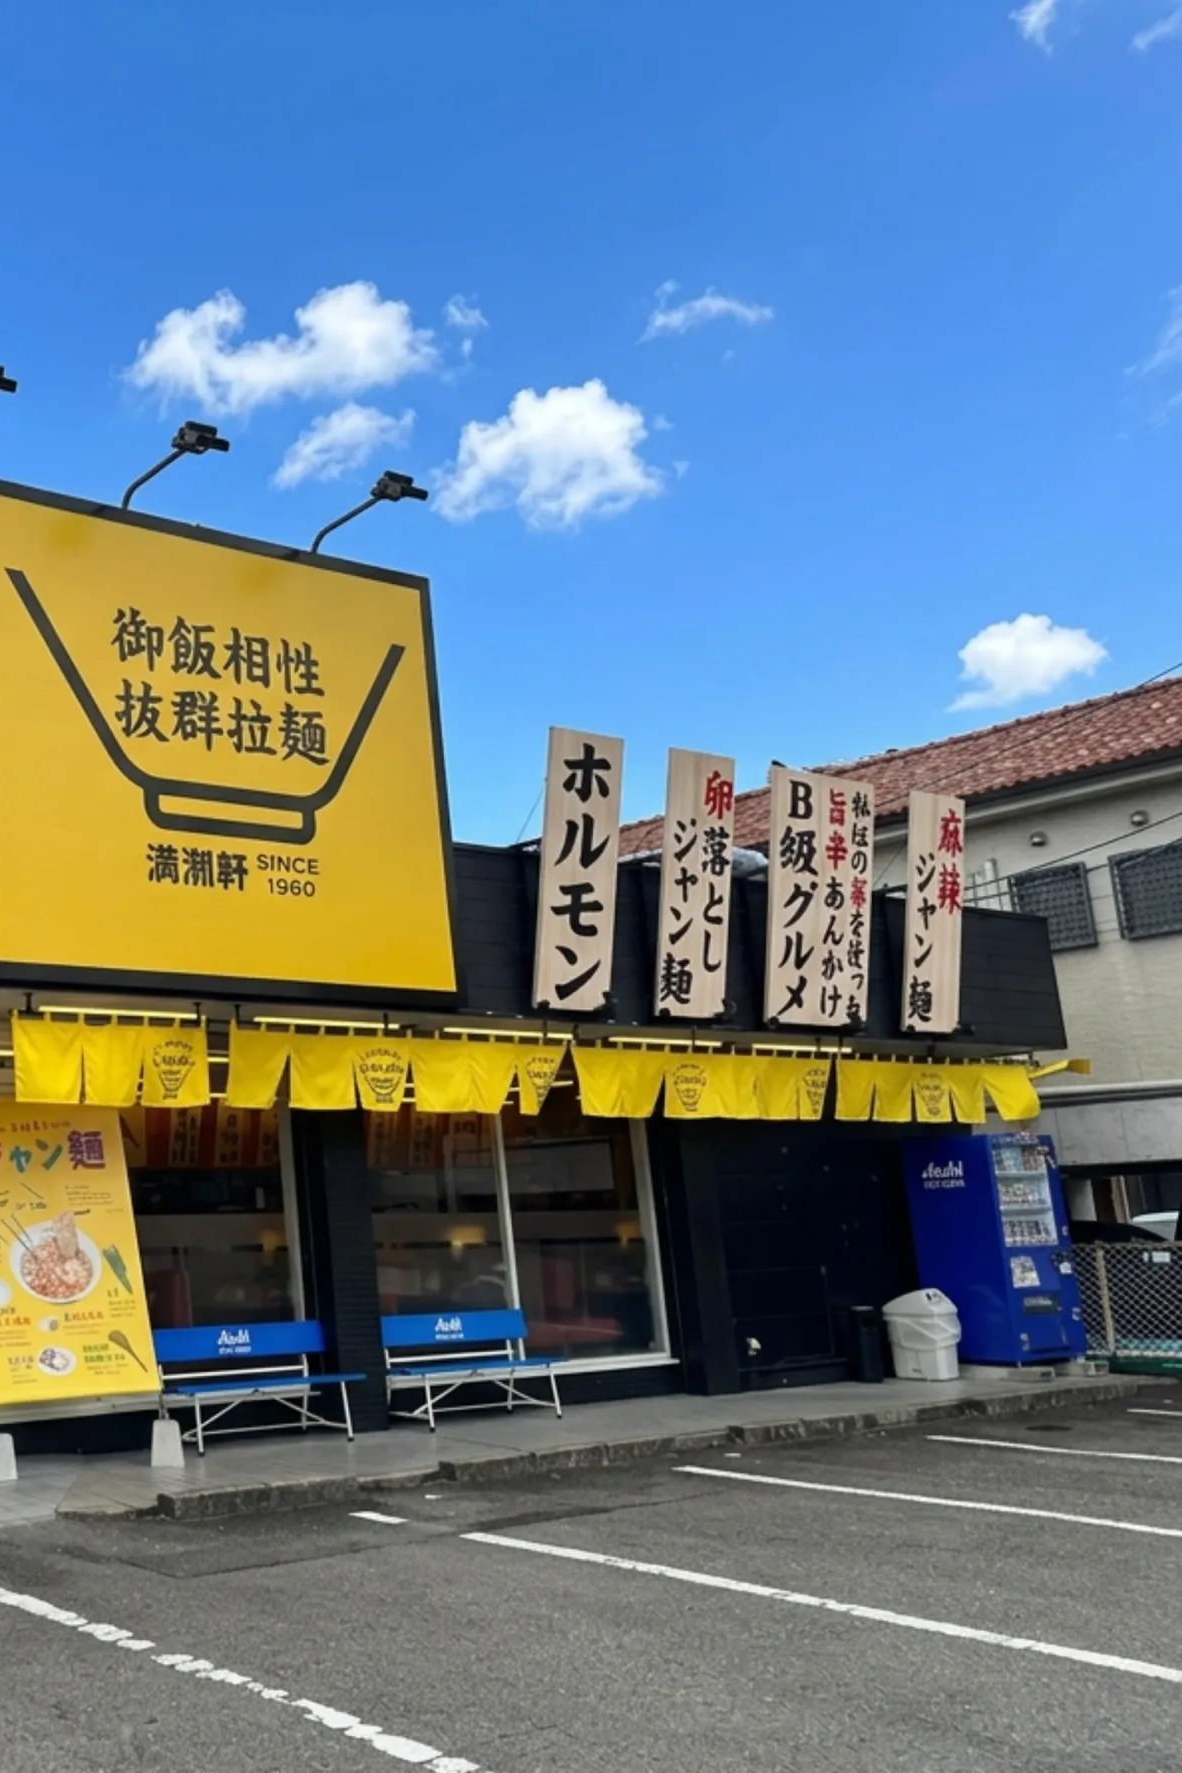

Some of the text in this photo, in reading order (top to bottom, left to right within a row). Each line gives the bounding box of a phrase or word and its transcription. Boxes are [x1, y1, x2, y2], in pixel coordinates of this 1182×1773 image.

[111, 606, 325, 696] 御飯相性
[115, 679, 330, 766] 抜群拉麺
[256, 854, 320, 876] SINCE
[267, 878, 316, 897] 1960
[550, 742, 611, 1001] ホルモン
[659, 818, 698, 1004] ジャン麺
[702, 770, 734, 973] 卵落とし
[775, 779, 819, 1016] B級グルメ
[820, 788, 848, 1018] 旨辛あんかけ
[908, 852, 937, 1023] ジャン麺
